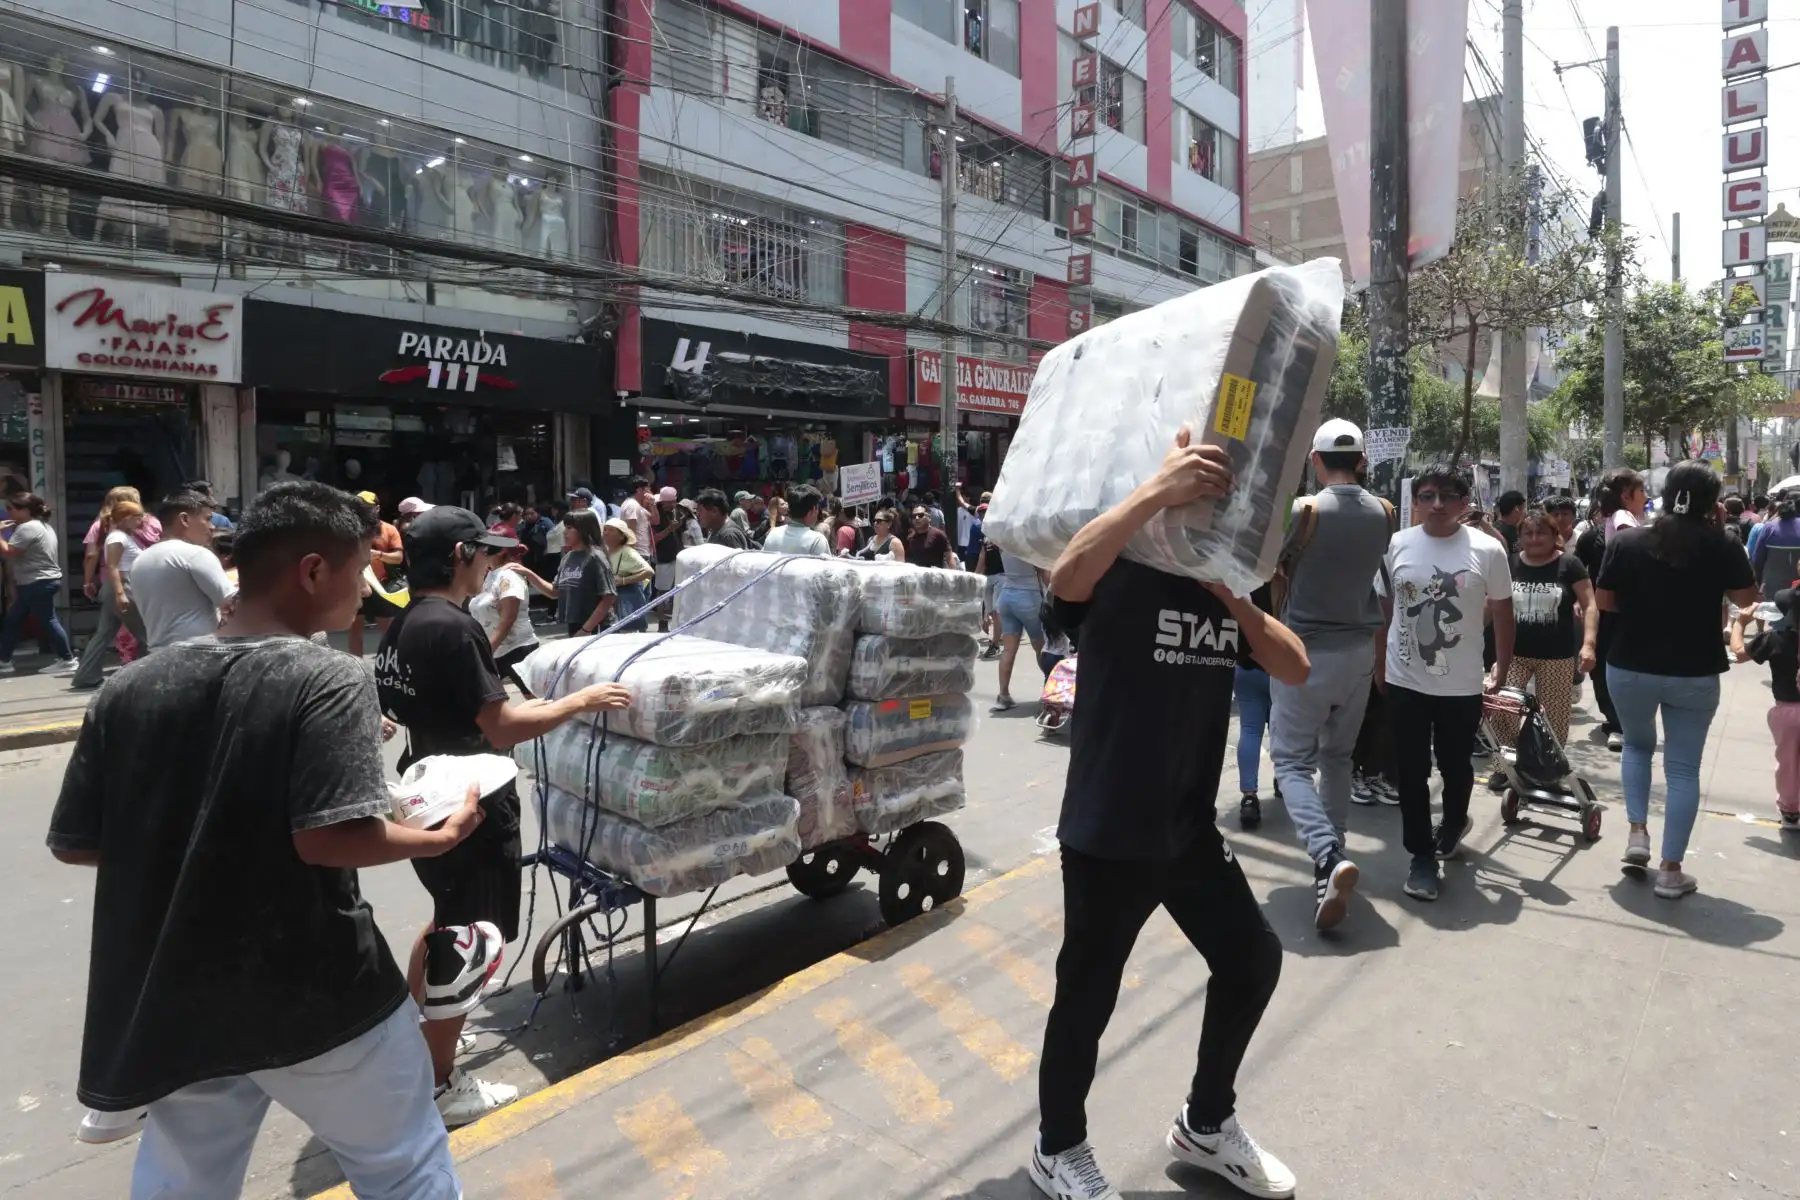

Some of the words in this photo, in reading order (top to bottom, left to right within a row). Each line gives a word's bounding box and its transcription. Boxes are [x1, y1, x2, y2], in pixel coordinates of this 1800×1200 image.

[76, 352, 219, 376] COLOMBIANAS
[398, 331, 508, 367] PARADA
[427, 360, 479, 393] 111
